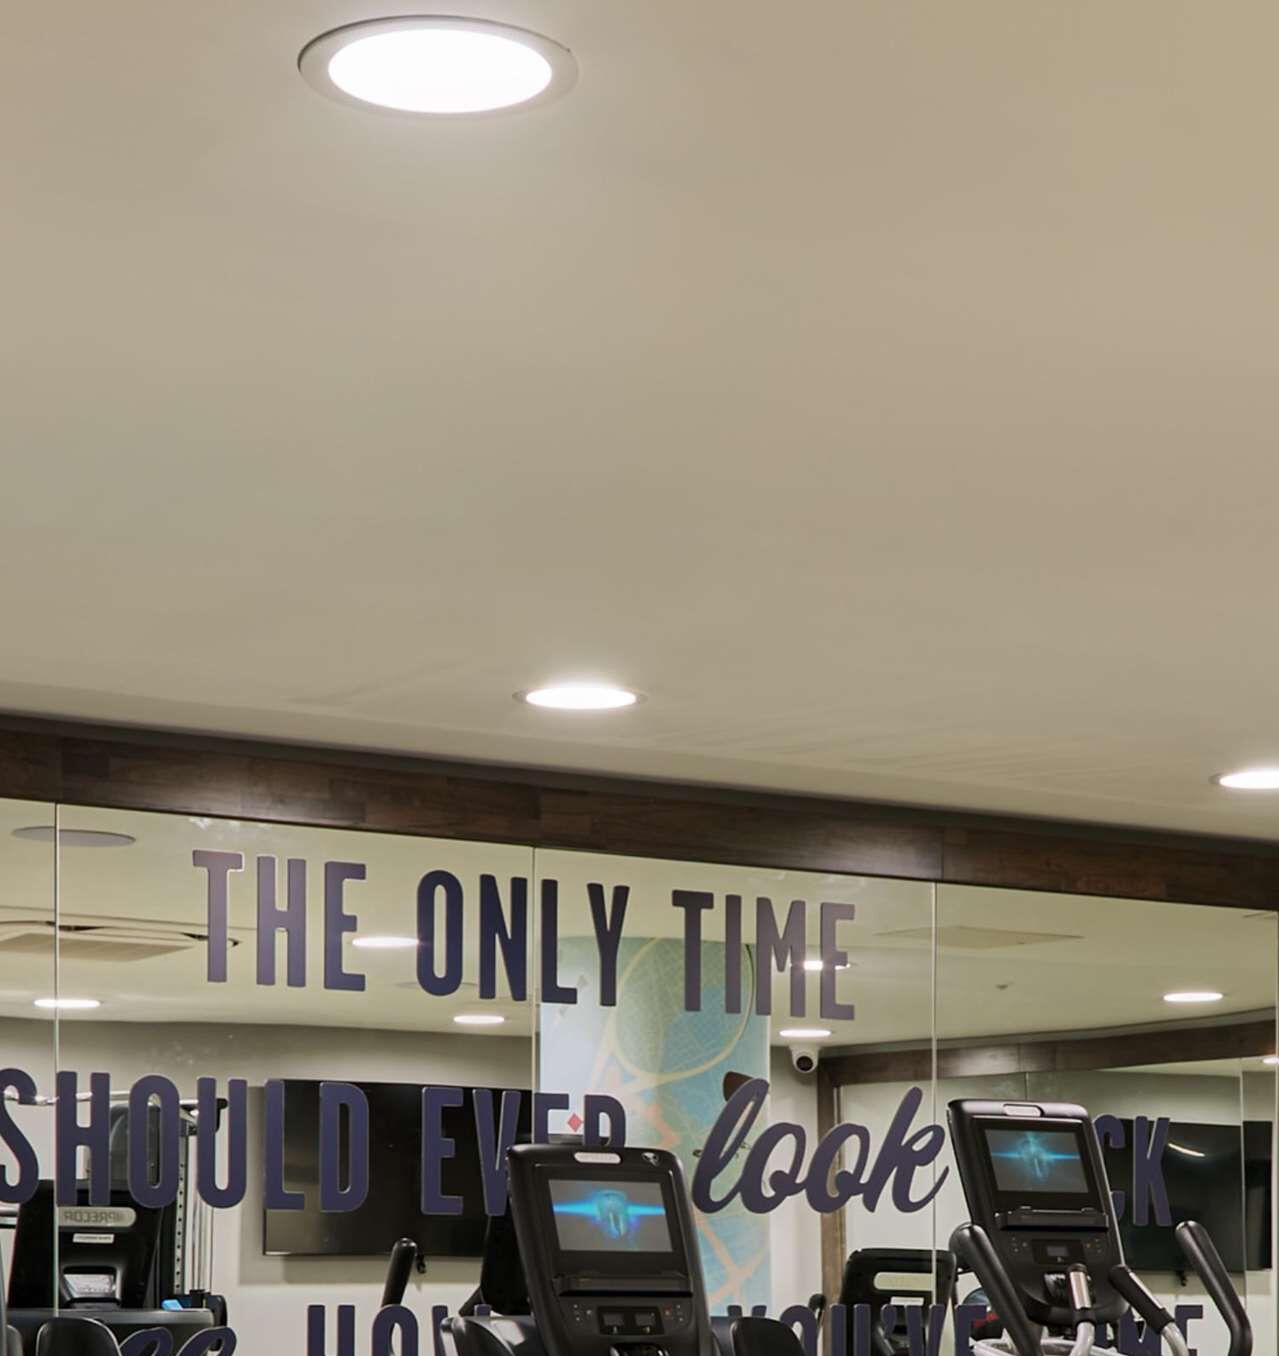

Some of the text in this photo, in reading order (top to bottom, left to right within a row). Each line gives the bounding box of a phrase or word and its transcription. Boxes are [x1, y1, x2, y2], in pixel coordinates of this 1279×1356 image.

[192, 849, 856, 1021] THE ONLY TIME
[692, 1077, 950, 1214] look
